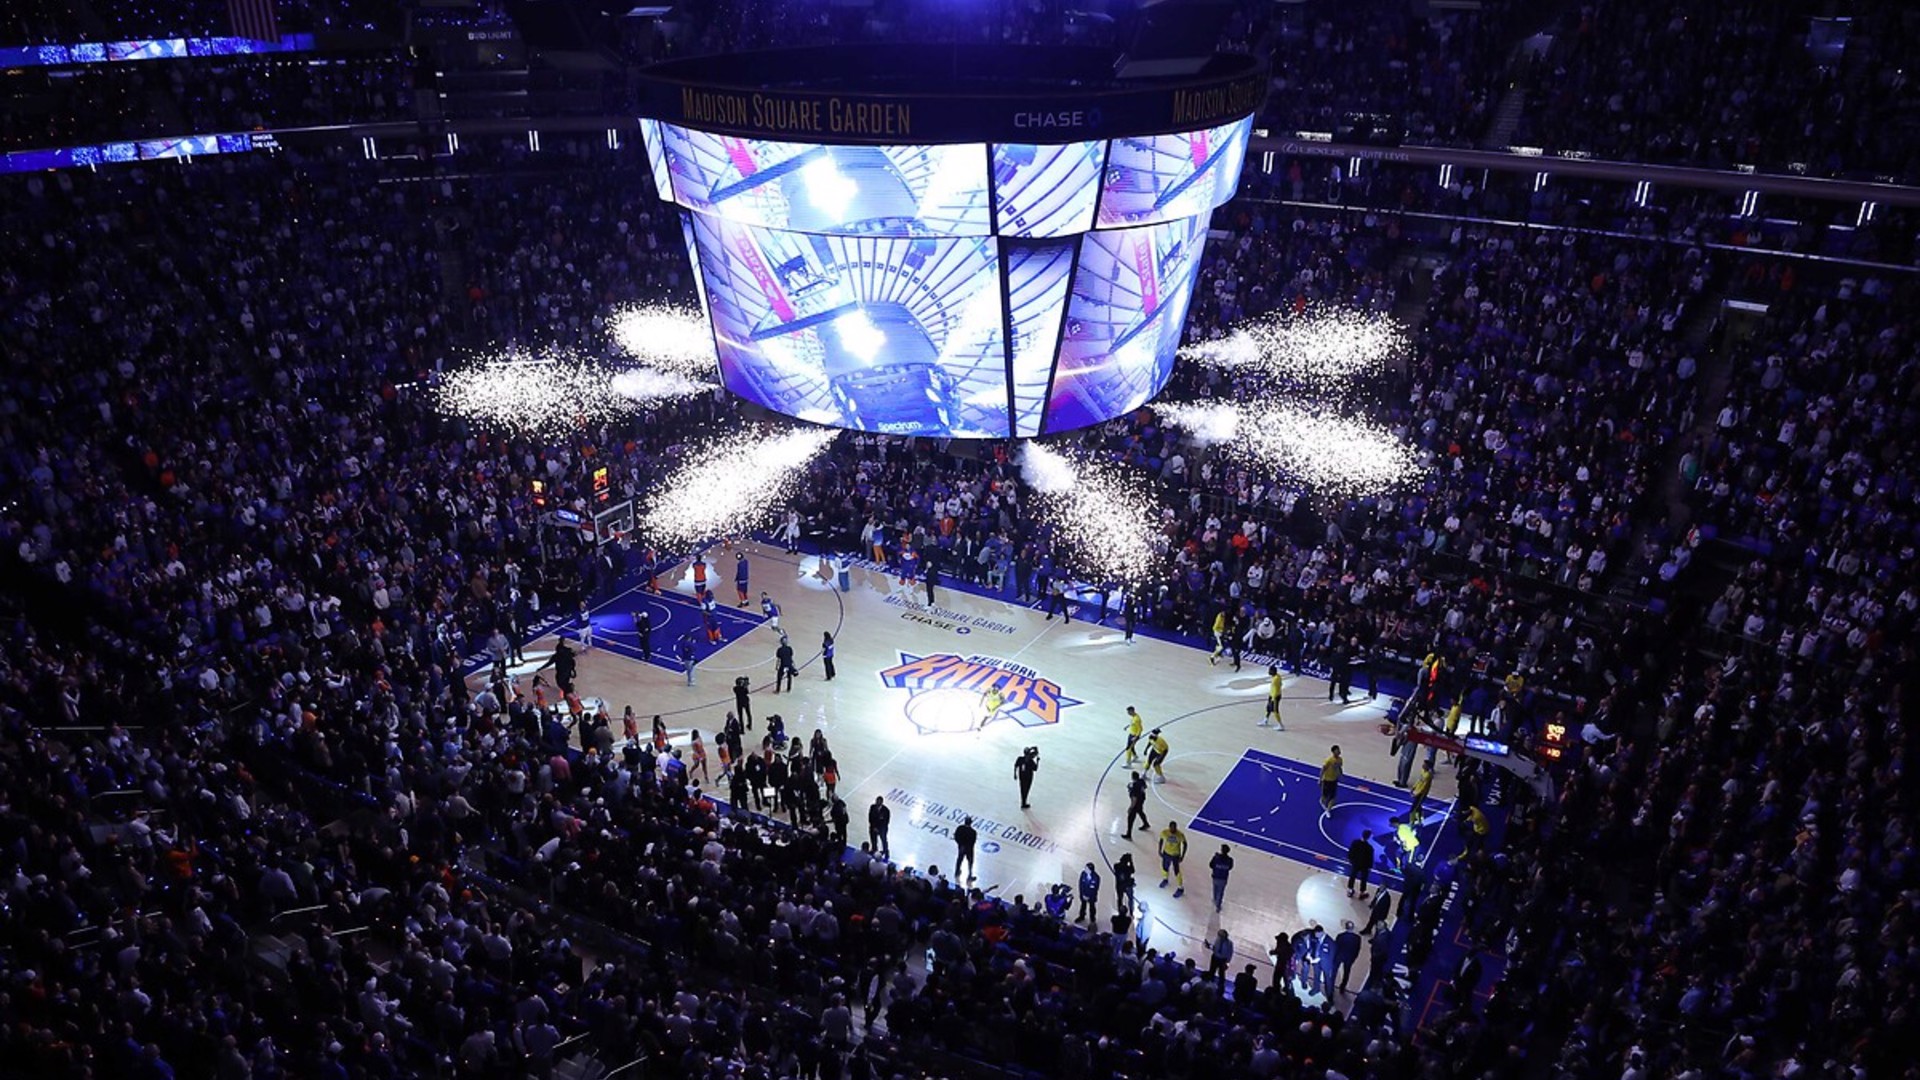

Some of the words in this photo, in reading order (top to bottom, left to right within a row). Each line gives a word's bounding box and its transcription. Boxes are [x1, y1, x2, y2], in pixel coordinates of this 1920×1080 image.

[682, 86, 748, 126] MADISON
[752, 92, 822, 131] SQUARE
[828, 98, 910, 134] GARDEN
[1013, 110, 1083, 128] CHASE
[1172, 87, 1226, 124] MADISON
[900, 612, 957, 632] CHASE
[930, 606, 971, 624] SQUARE
[971, 616, 1017, 635] GARDEN
[967, 655, 1002, 667] NEW
[1002, 661, 1037, 679] YORK
[881, 653, 1060, 726] KNICKS
[1000, 825, 1059, 854] GARDEN
